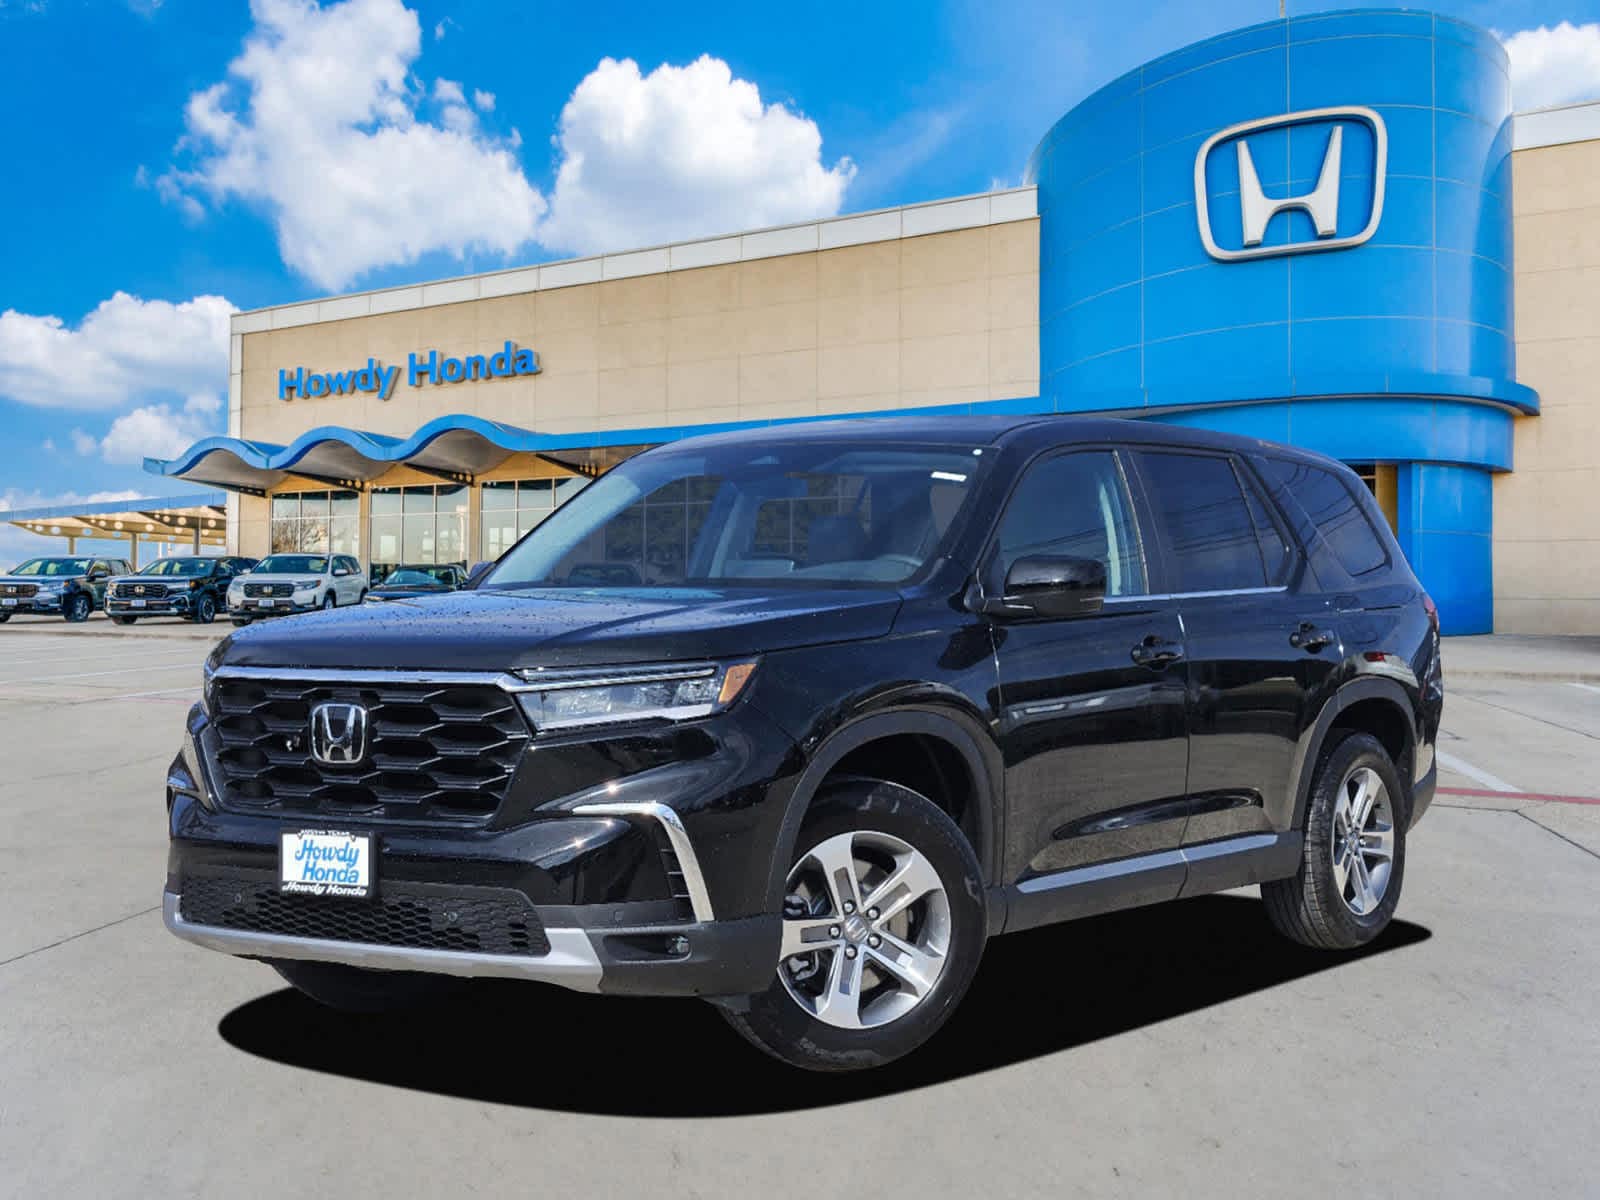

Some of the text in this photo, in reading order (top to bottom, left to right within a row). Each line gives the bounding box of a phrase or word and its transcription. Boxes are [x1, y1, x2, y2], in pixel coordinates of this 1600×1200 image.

[278, 340, 541, 400] Howdy Honda
[295, 839, 360, 868] Howdy
[302, 860, 360, 883] Honda
[281, 880, 368, 896] Howdy Honda
